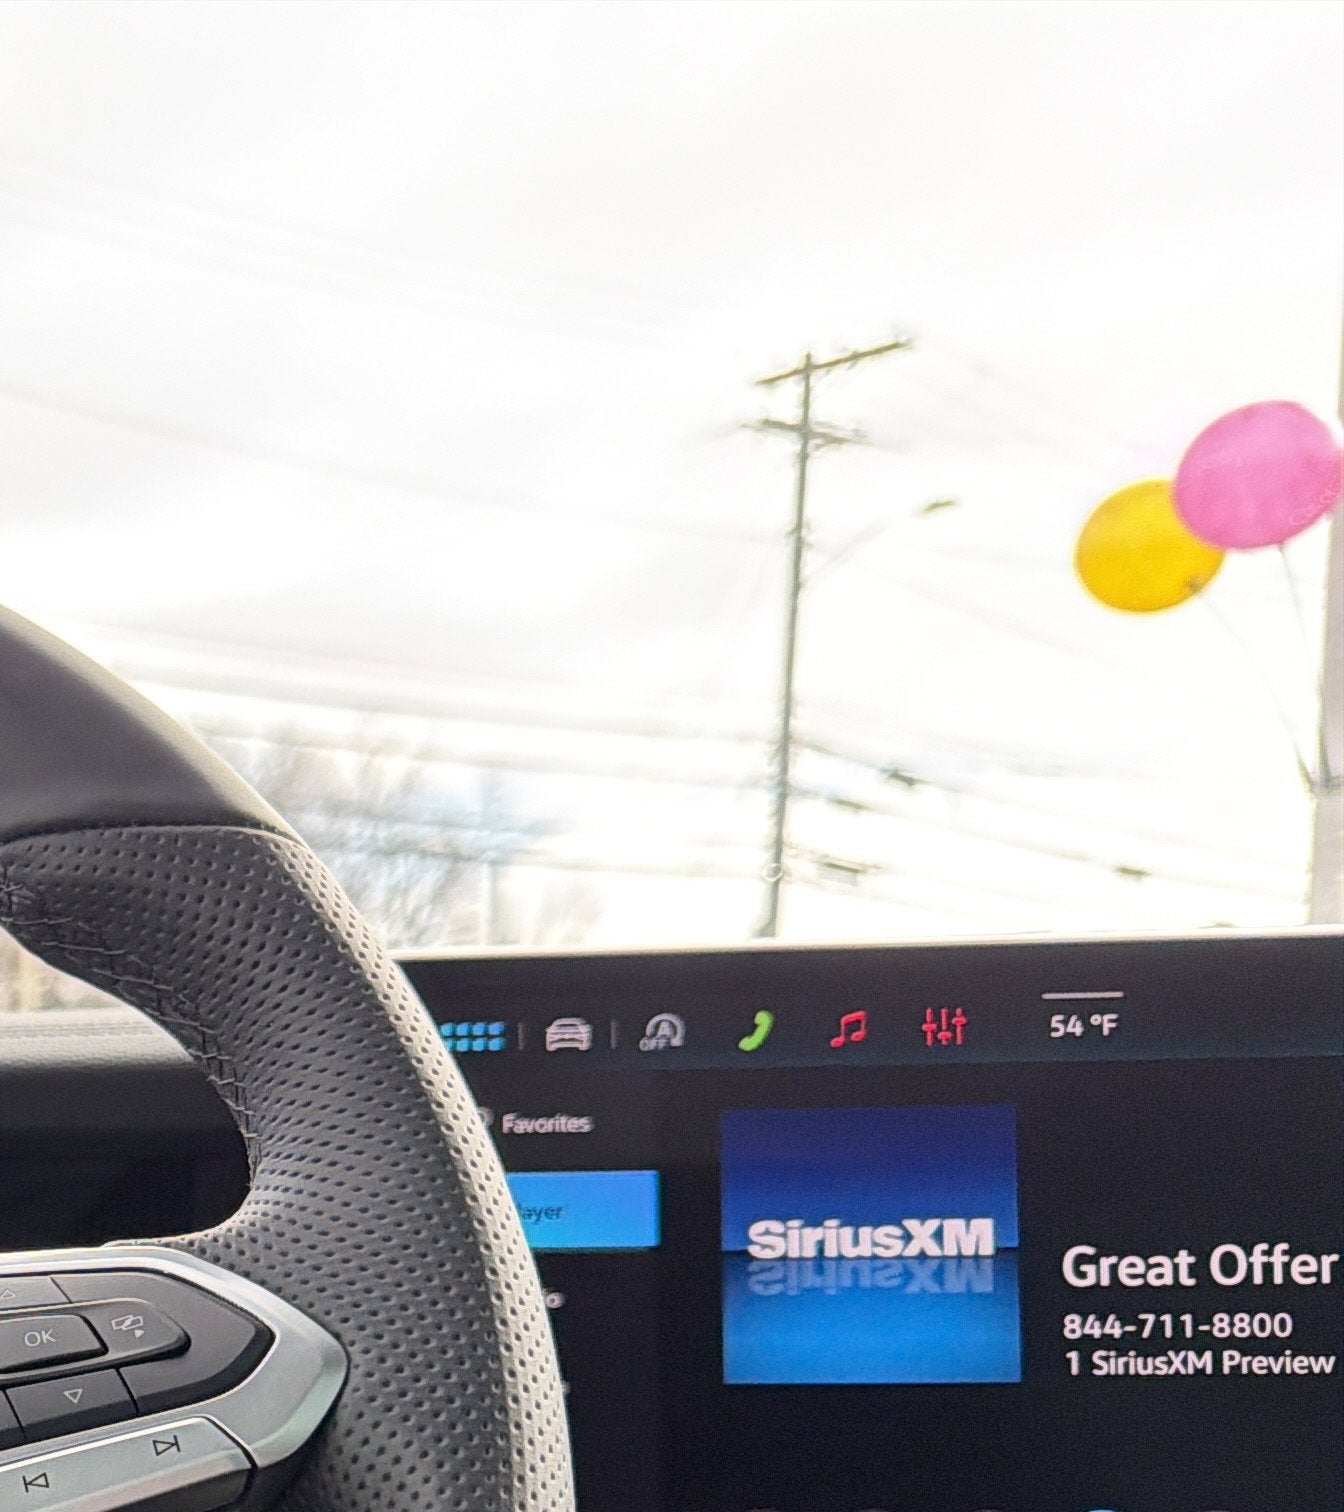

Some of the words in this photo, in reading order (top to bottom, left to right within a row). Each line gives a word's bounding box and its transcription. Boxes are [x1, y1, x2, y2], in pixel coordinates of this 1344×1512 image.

[1050, 1014, 1084, 1038] 54
[502, 1112, 594, 1134] Favorites
[747, 1218, 995, 1259] SiriusXM
[1062, 1244, 1197, 1287] Great
[1210, 1242, 1340, 1286] Offer
[23, 1328, 57, 1347] OK
[1063, 1312, 1293, 1340] 844-711-8800
[1065, 1350, 1081, 1376] 1
[1091, 1349, 1213, 1376] SiriusXM
[1222, 1348, 1336, 1375] Preview
